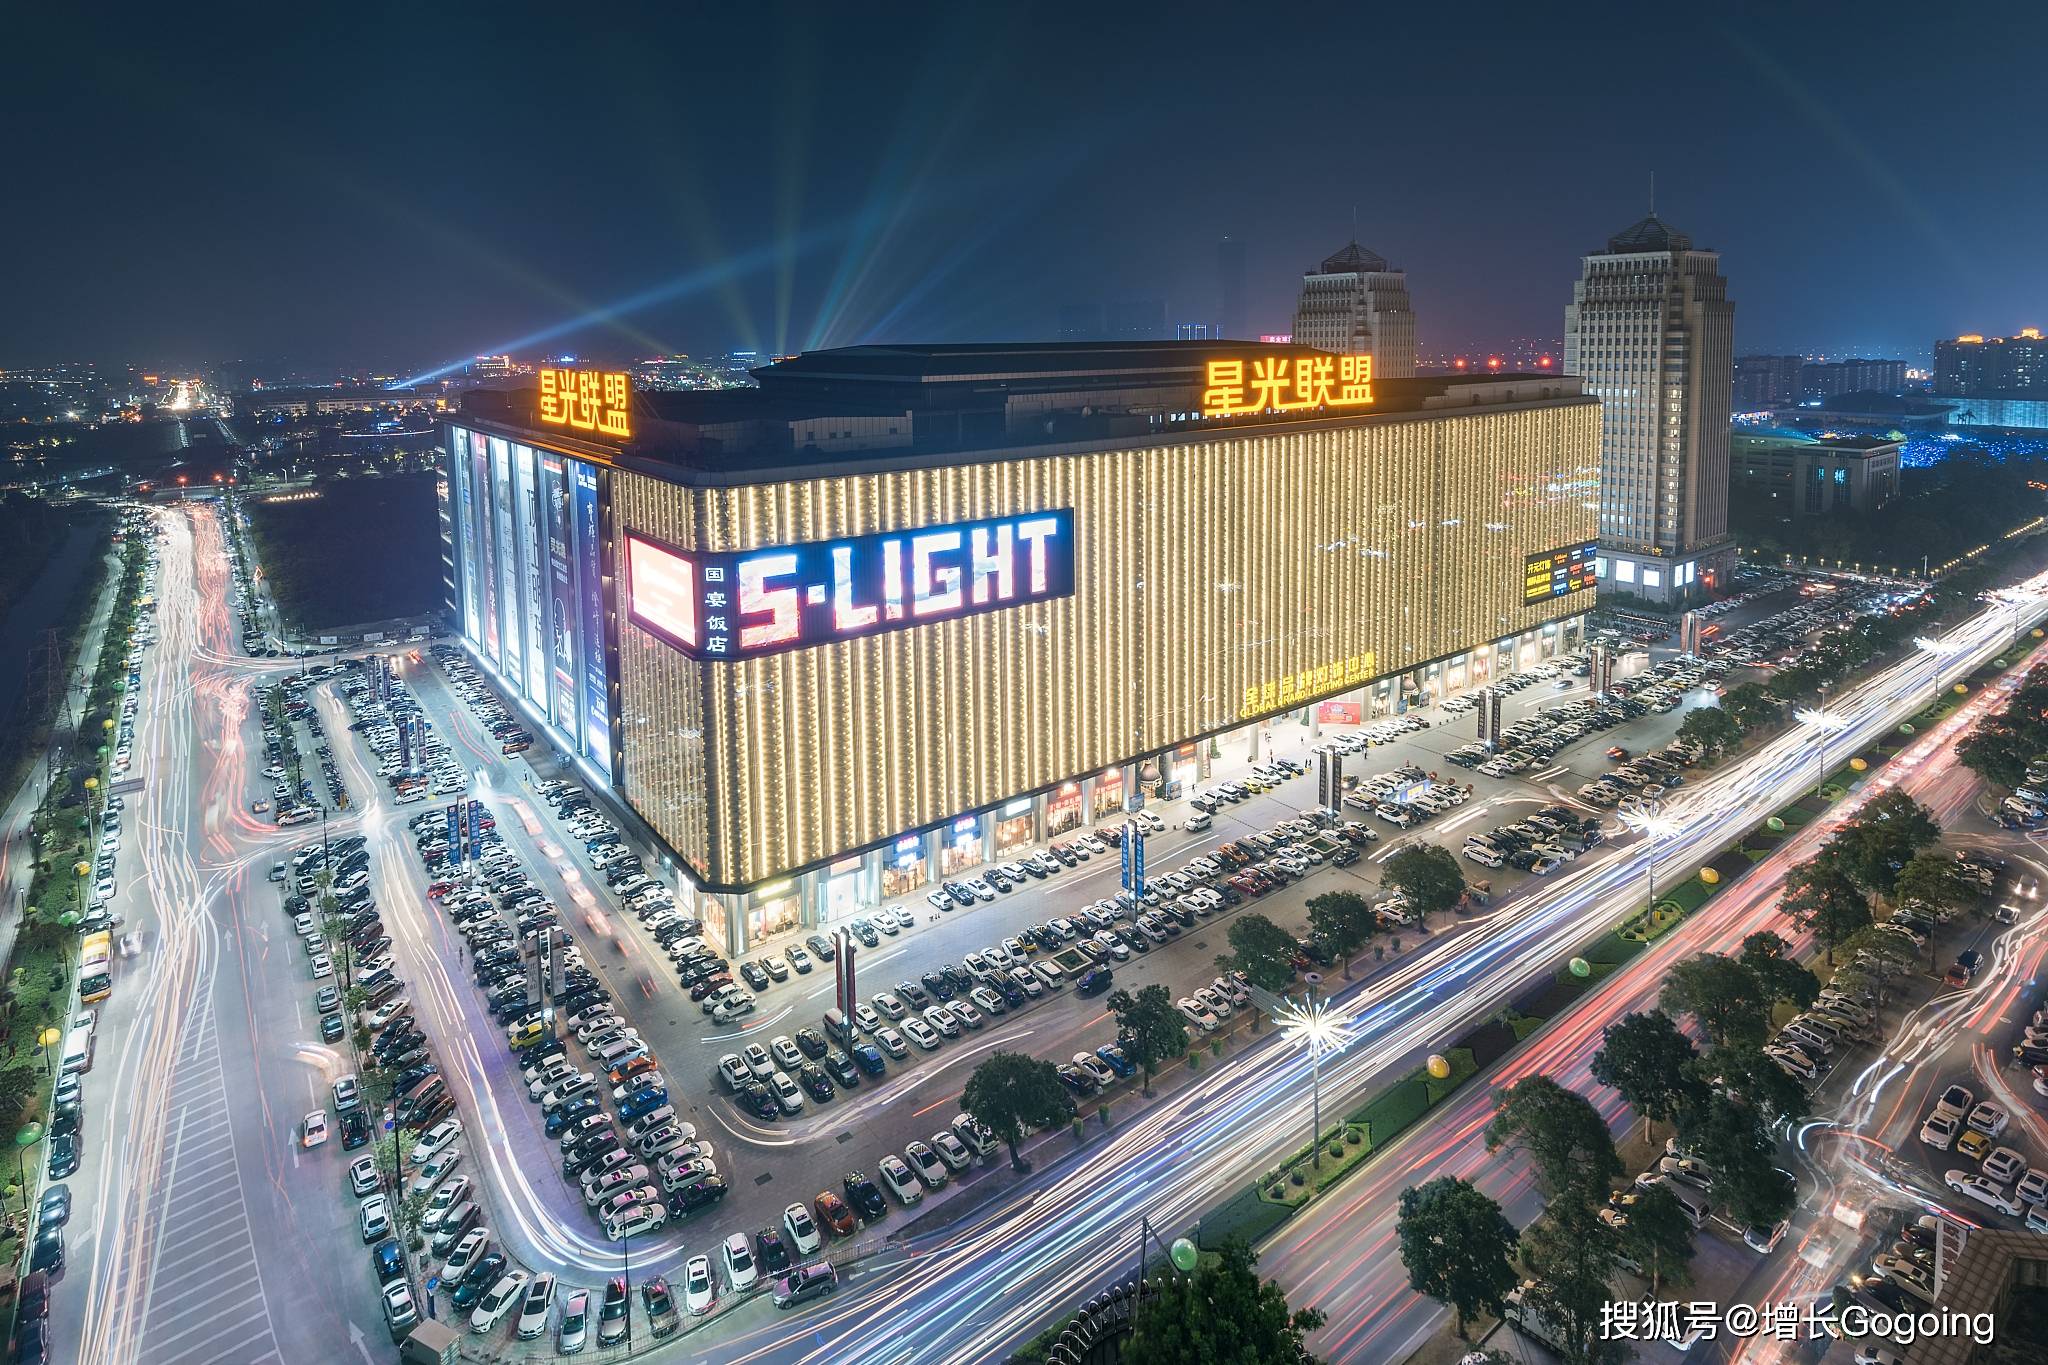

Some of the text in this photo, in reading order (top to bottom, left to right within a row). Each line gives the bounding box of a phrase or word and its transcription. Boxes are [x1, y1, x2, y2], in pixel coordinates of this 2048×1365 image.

[540, 369, 630, 437] 星光联盟
[1204, 355, 1374, 416] 星光联盟
[704, 567, 729, 653] 国宴饭店
[1239, 701, 1277, 718] GLOBAL
[1308, 678, 1344, 696] LIGHTING
[1345, 668, 1375, 685] CENTER
[1246, 651, 1375, 705] 全球品牌灯饰中心
